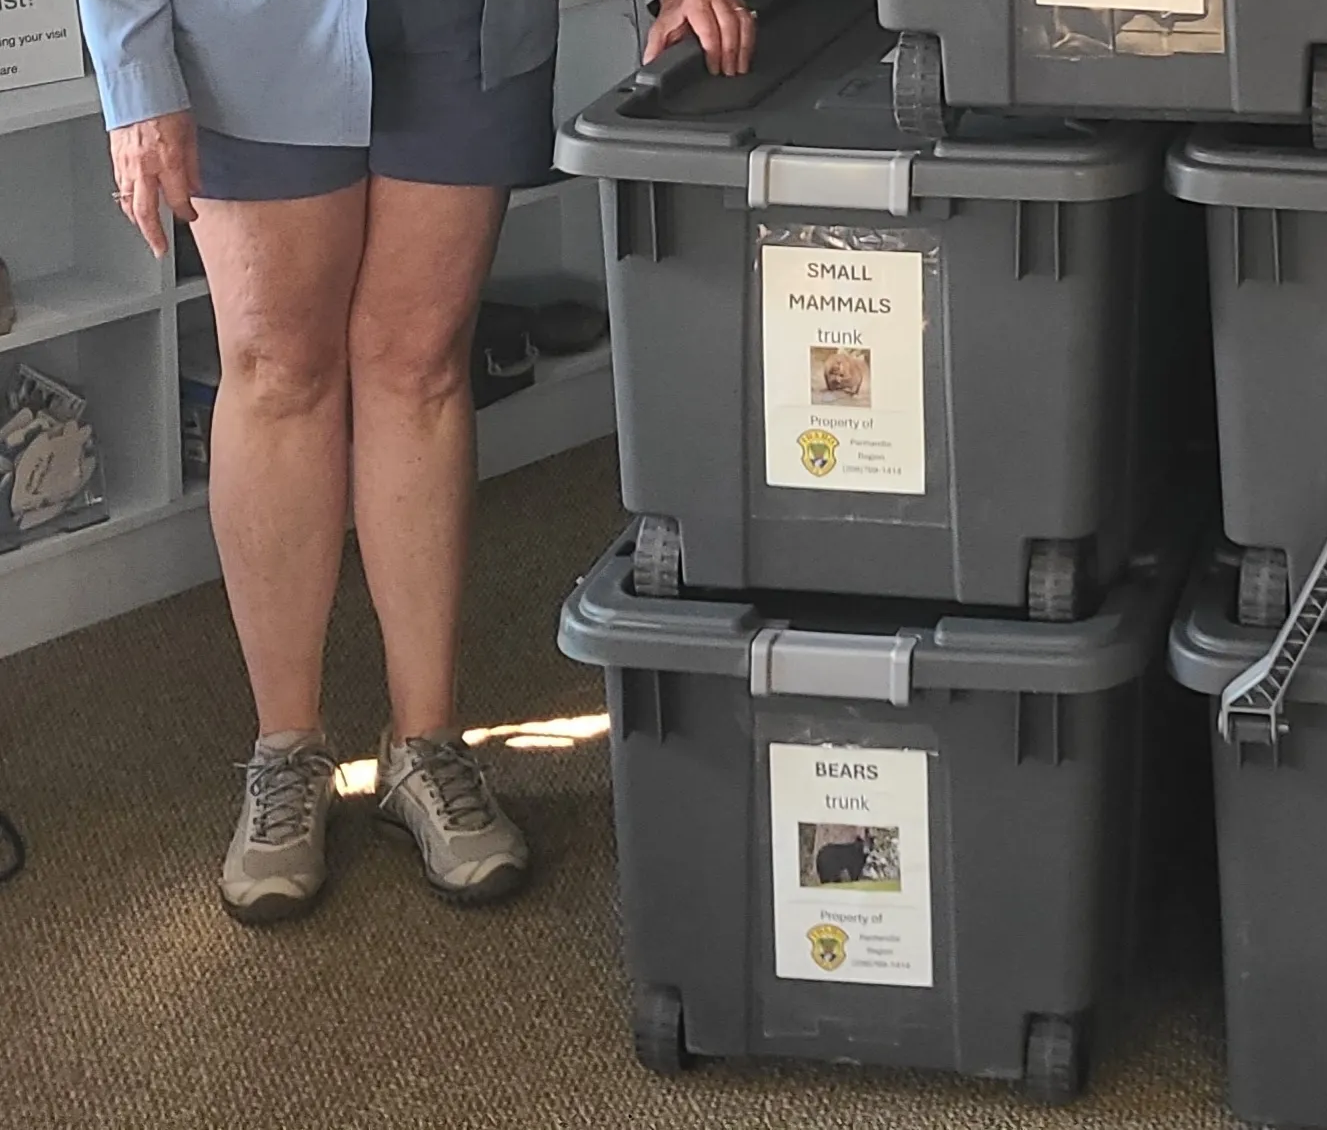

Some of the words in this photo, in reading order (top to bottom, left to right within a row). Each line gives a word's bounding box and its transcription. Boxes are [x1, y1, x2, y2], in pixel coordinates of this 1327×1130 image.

[18, 33, 42, 47] your
[46, 28, 67, 40] visit
[807, 262, 873, 281] SMALL
[789, 293, 891, 313] MAMMALS
[817, 328, 863, 345] trunk
[810, 415, 860, 430] Property
[862, 418, 874, 429] of
[815, 761, 879, 780] BEARS
[825, 793, 870, 811] trunk
[820, 910, 869, 925] Property
[871, 913, 883, 923] of
